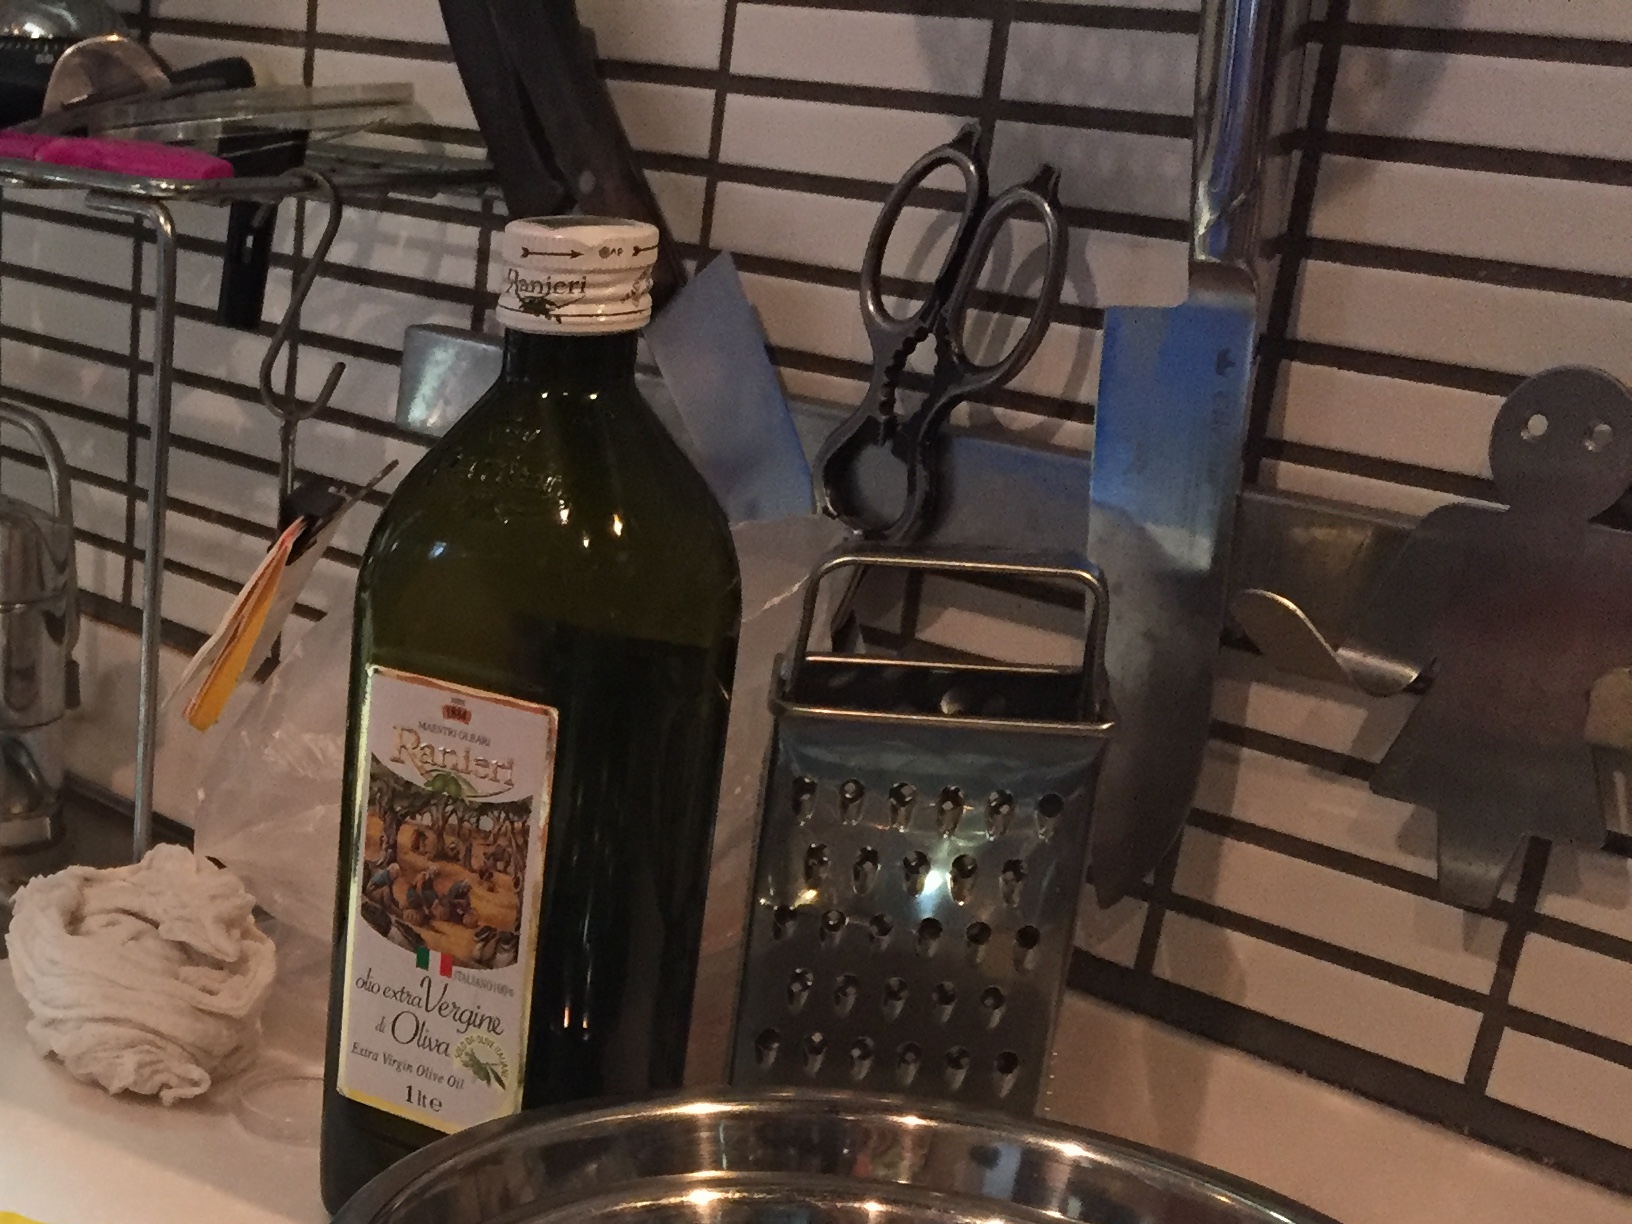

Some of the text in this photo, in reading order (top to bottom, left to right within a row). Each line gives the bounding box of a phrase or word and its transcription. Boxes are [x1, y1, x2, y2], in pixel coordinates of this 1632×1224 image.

[418, 721, 457, 738] MAESTRI
[390, 725, 515, 786] Ranieri
[355, 967, 504, 1036] olio extra Vergine
[374, 1010, 451, 1058] di Oliva
[351, 1041, 465, 1090] Extra Virgin Olive Oil
